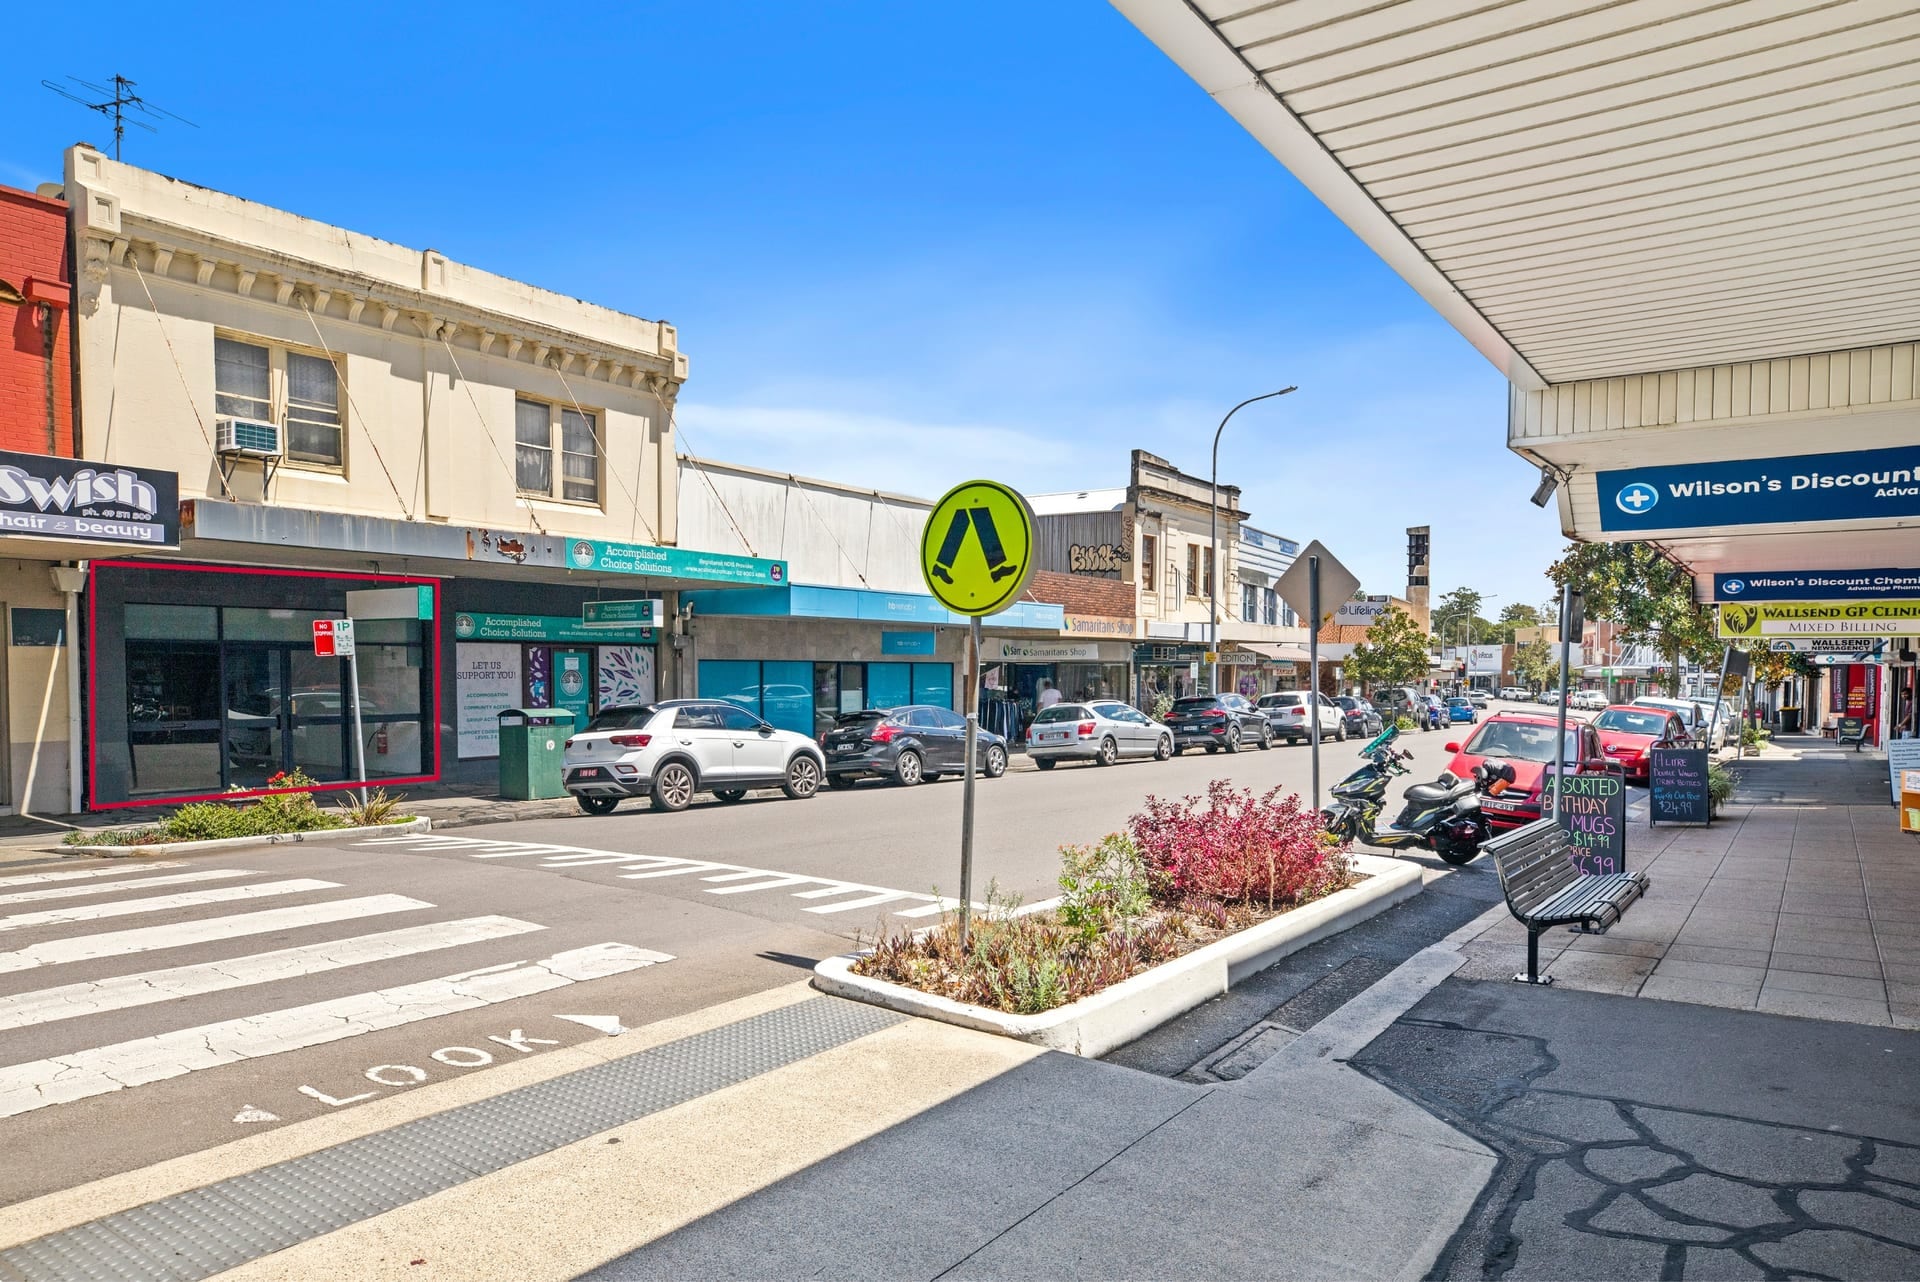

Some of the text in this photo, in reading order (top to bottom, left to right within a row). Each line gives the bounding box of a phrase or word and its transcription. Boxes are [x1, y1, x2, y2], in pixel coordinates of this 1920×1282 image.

[1669, 465, 1920, 498] Wilson's Discount
[0, 465, 157, 514] Swish
[1874, 487, 1920, 498] Adva
[0, 514, 151, 539] hair & beauty
[605, 546, 667, 561] Accomplished
[600, 558, 672, 573] Choice Solutions
[1750, 577, 1805, 587] Wilson's
[1808, 577, 1870, 587] Discount
[1349, 605, 1383, 616] Lifeline
[1763, 606, 1920, 618] WALLSEND GP CLINI
[336, 621, 350, 631] 1P
[485, 616, 541, 628] Accomplished
[1072, 618, 1134, 634] Samaritans Shop
[1788, 621, 1897, 632] MIXED BILLING
[480, 627, 546, 638] Choice Solutions
[1029, 648, 1068, 657] Samaritans
[1069, 647, 1087, 657] Shop
[1221, 653, 1254, 663] EDITION
[472, 661, 502, 670] LET US
[457, 671, 516, 680] SUPPORT YOU!
[1545, 777, 1619, 796] ASORTED
[1543, 795, 1608, 816] BTHDAY
[1571, 814, 1616, 835] MUGS
[1573, 830, 1610, 849] $14.99
[298, 1029, 560, 1107] LOOK
